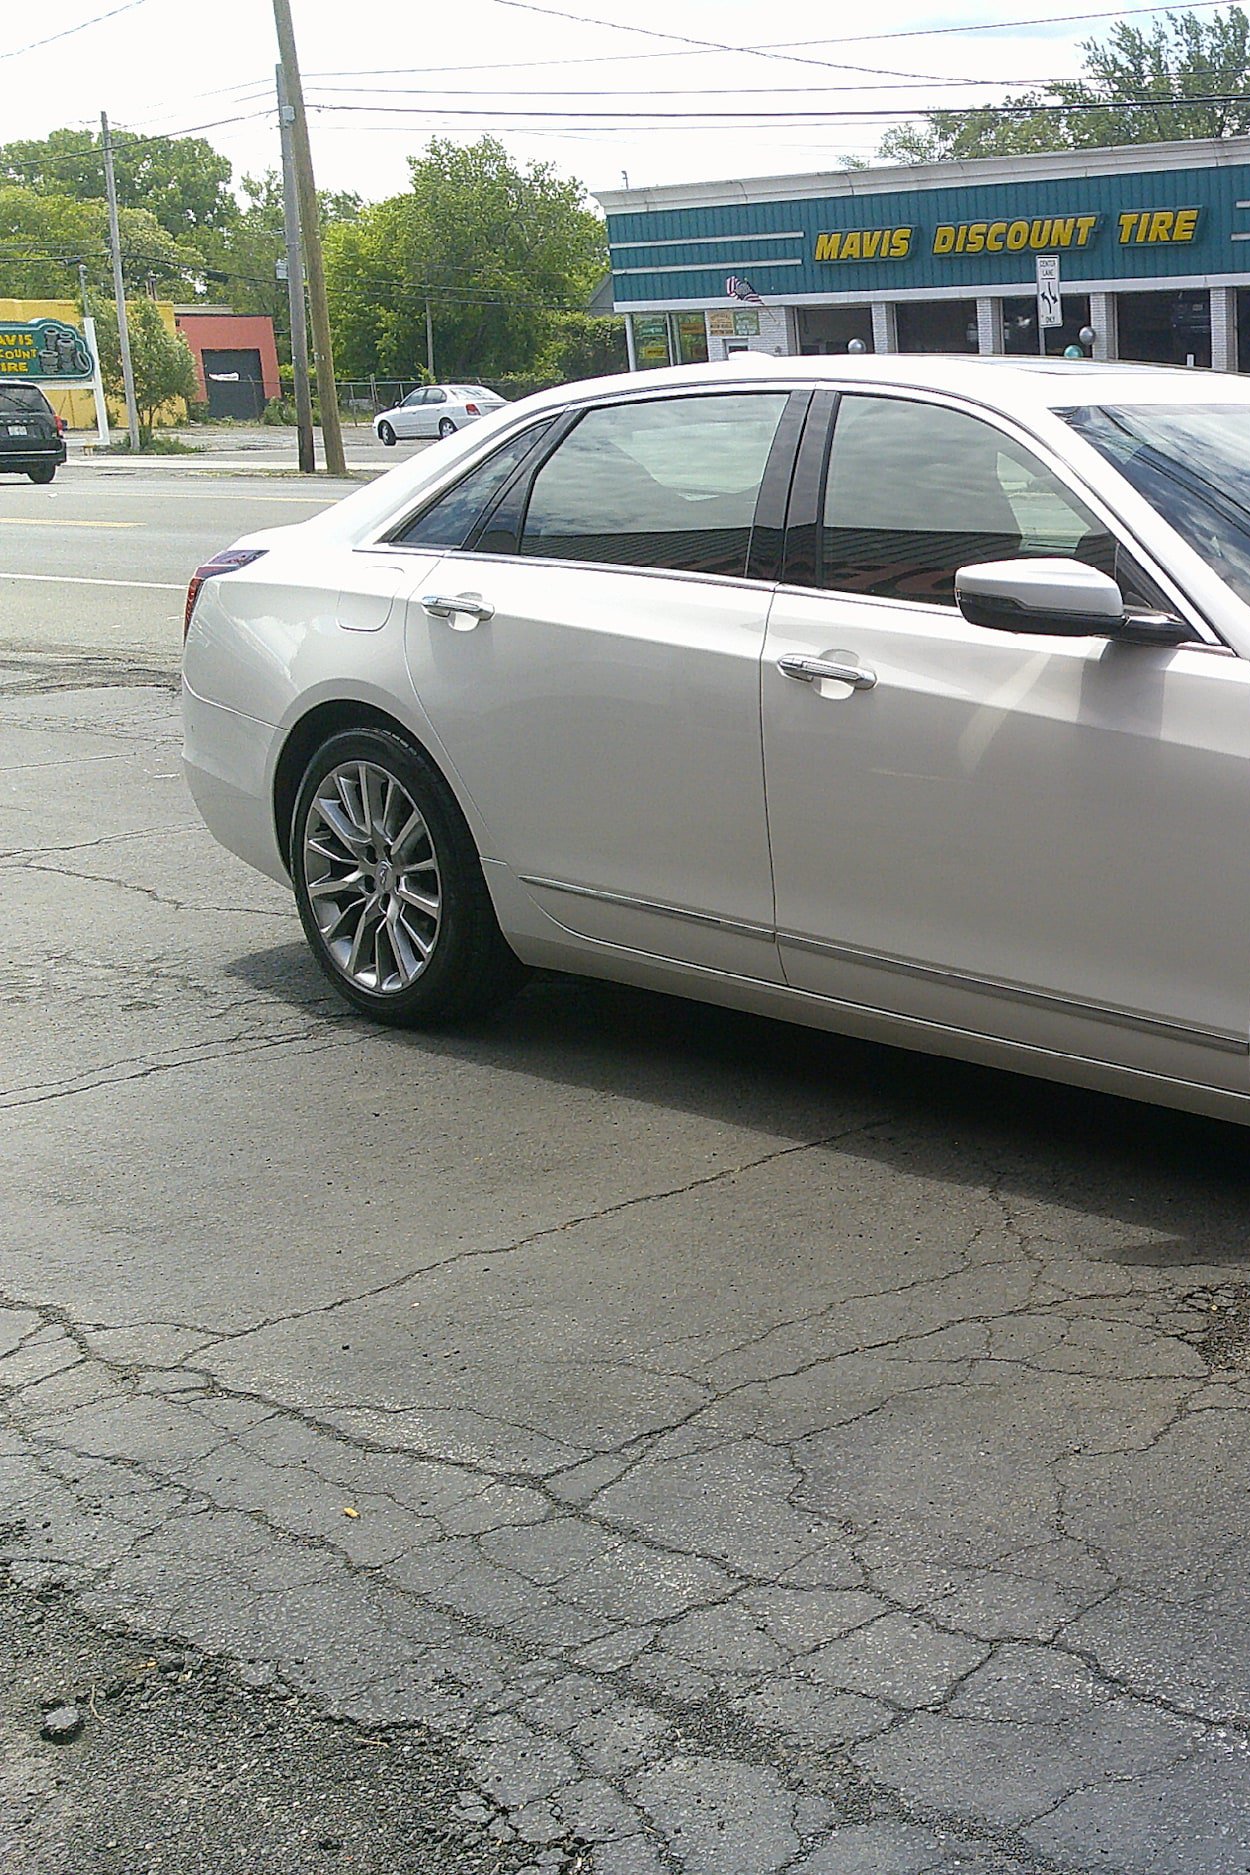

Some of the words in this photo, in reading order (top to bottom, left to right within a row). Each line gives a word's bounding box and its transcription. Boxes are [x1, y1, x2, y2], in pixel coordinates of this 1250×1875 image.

[814, 228, 912, 262] MAVIS
[932, 215, 1097, 255] DISCOUNT
[1118, 209, 1199, 244] TIRE
